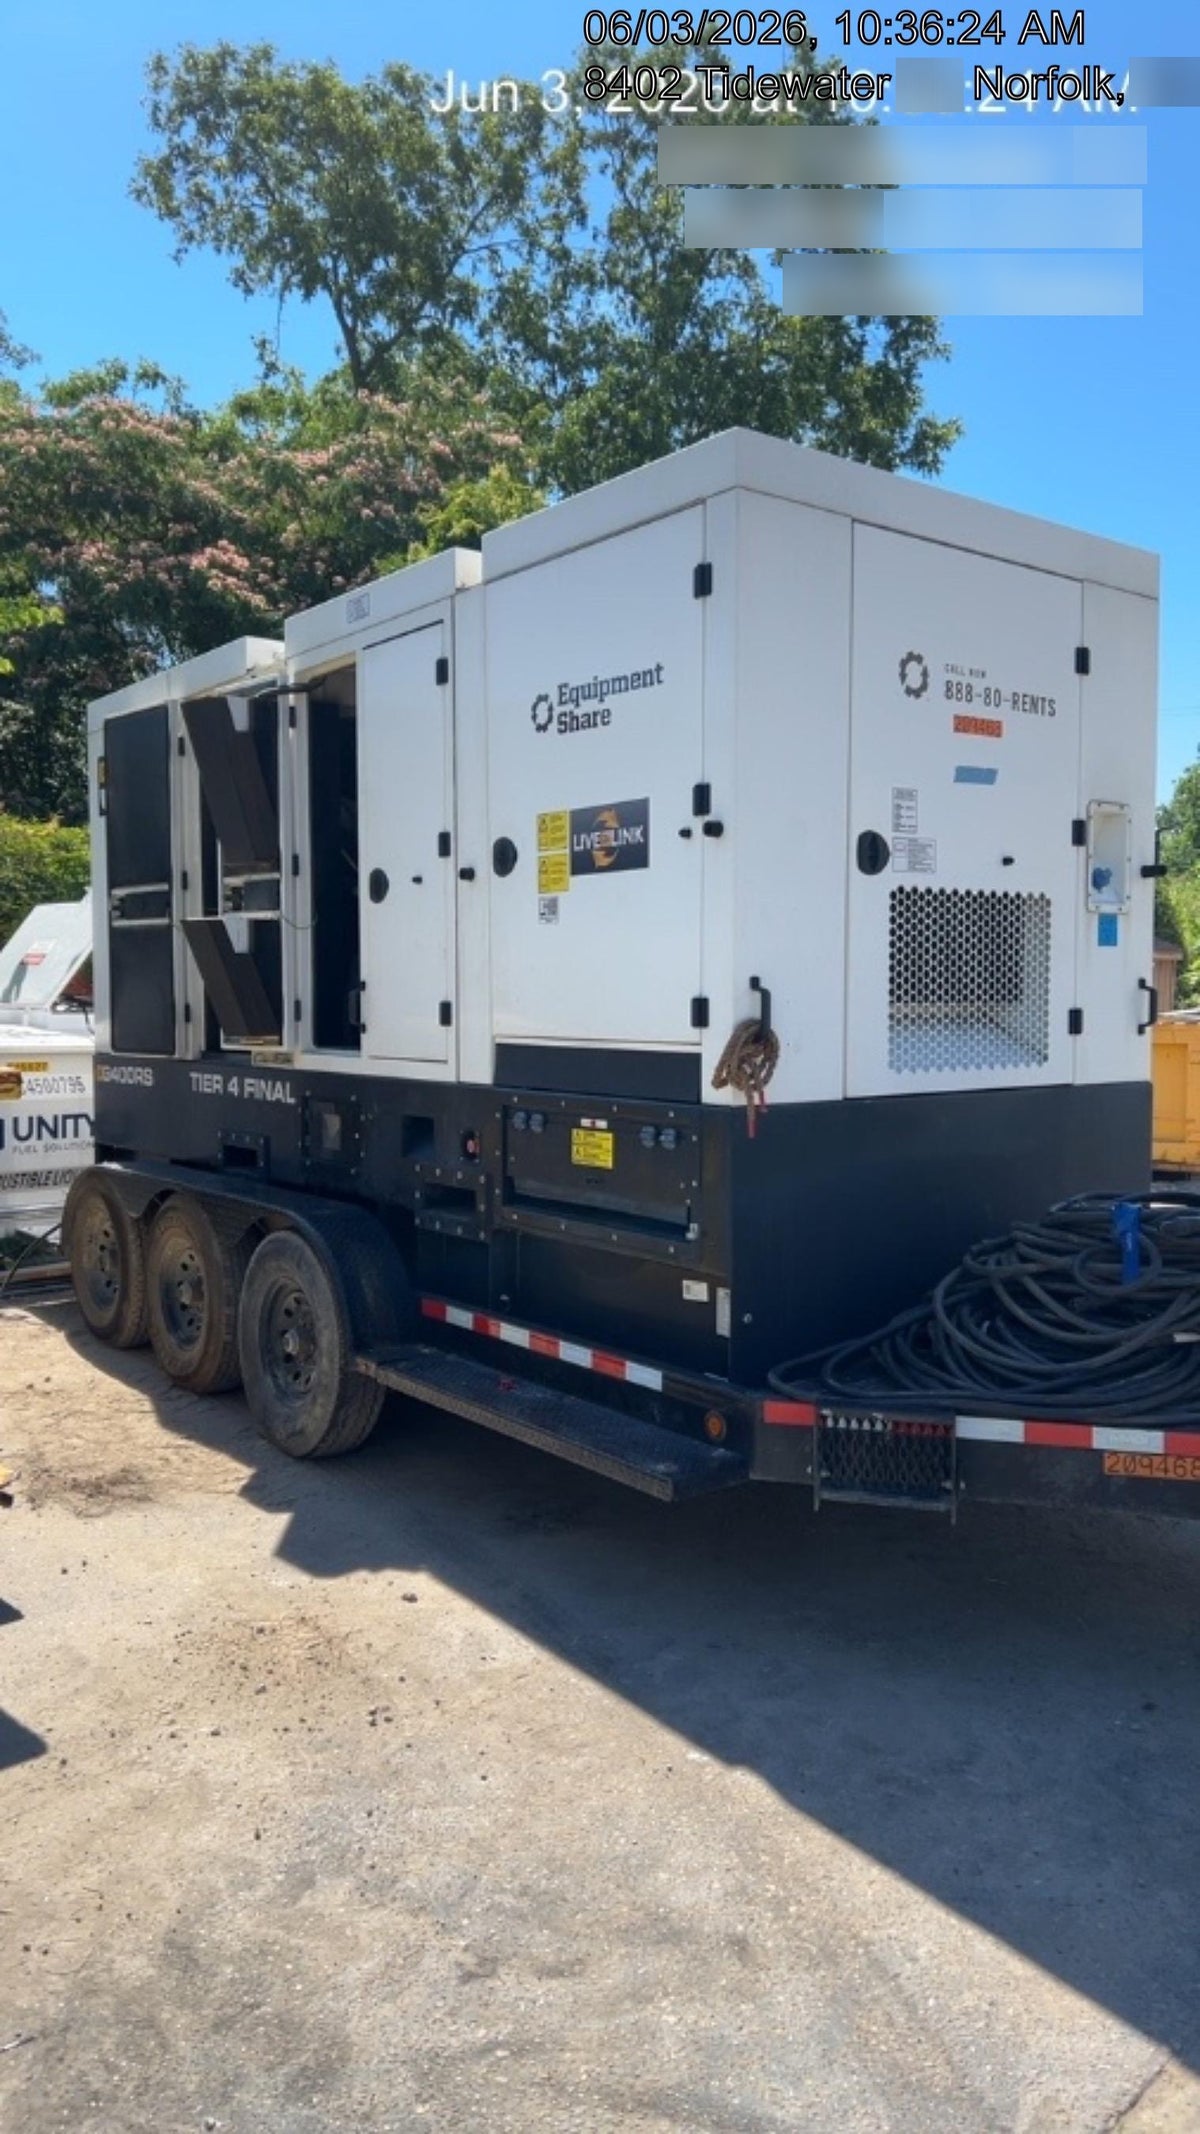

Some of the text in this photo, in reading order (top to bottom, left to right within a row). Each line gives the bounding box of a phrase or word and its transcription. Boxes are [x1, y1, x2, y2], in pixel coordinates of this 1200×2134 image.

[557, 662, 664, 708] Equipment
[945, 680, 1057, 717] 888-80-RENTS
[557, 708, 612, 734] Share
[190, 1071, 296, 1104] TIER 4 FINAL
[1106, 1451, 1200, 1478] 209468
